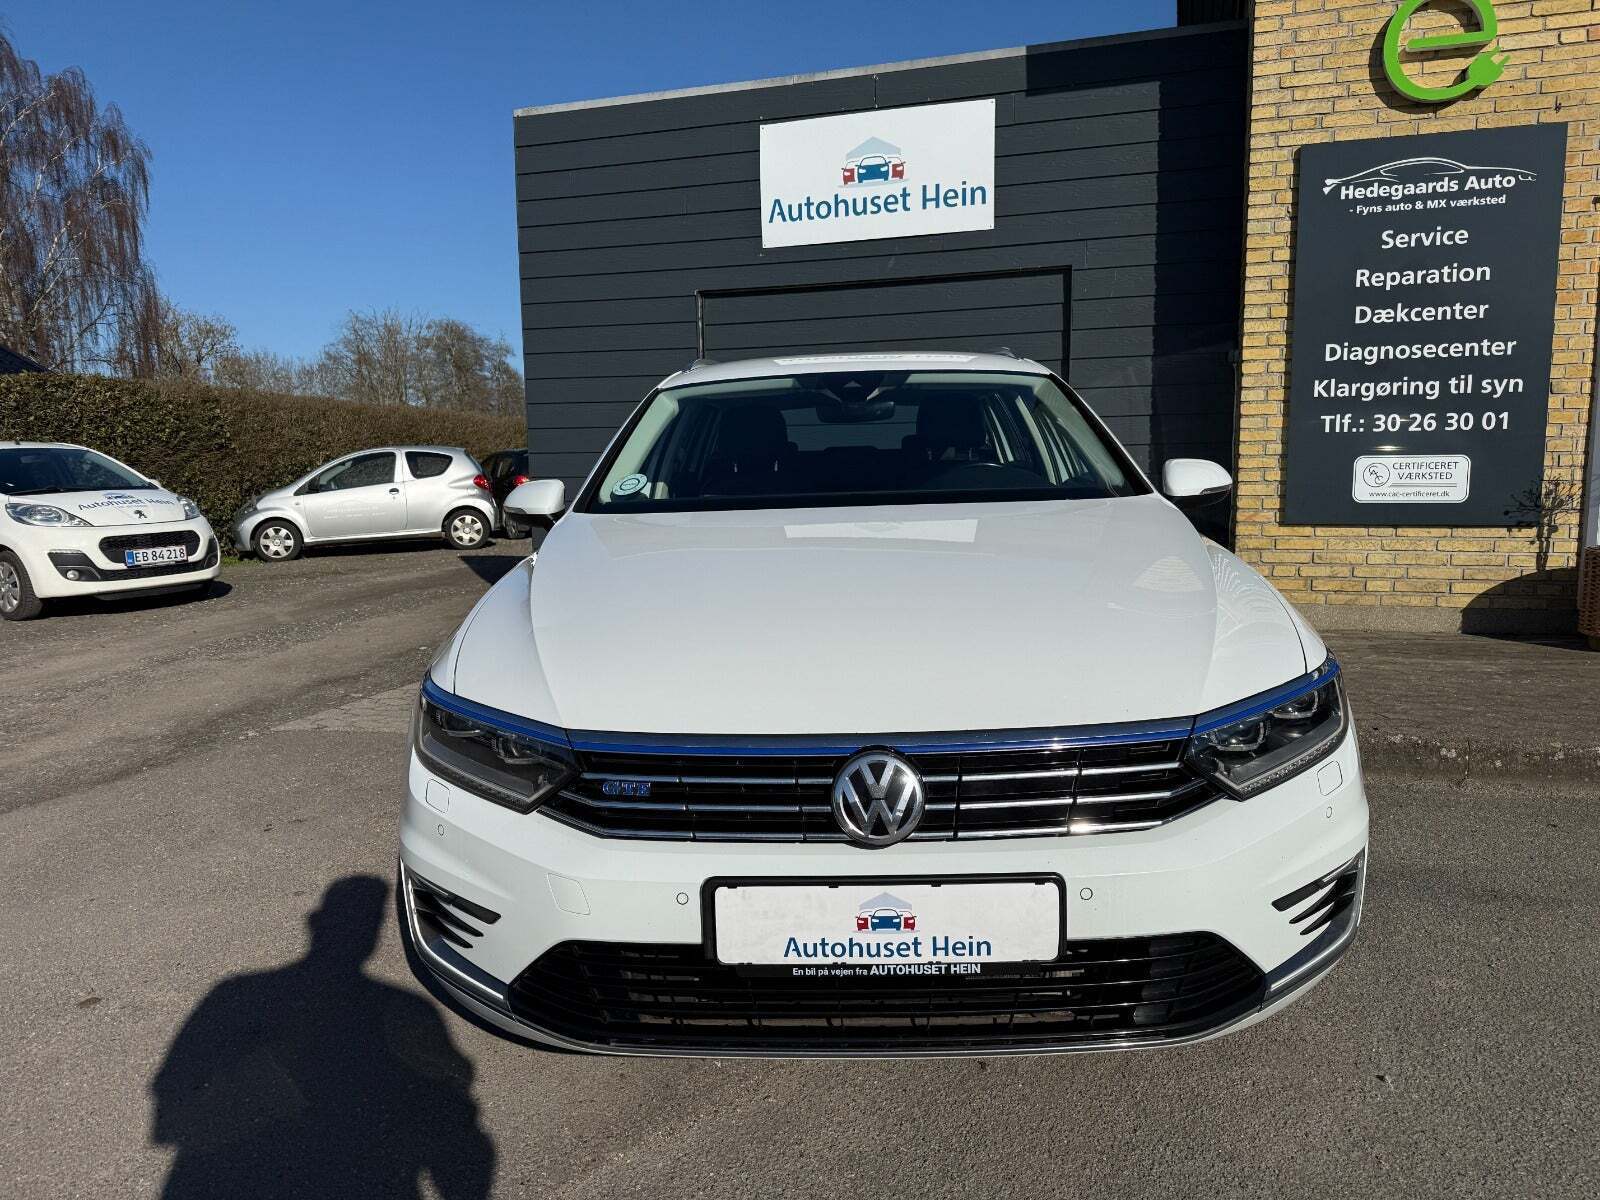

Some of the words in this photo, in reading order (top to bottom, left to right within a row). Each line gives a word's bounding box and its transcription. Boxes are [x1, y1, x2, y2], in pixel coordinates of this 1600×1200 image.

[1340, 177, 1459, 200] Hedegaards
[1464, 174, 1516, 191] Auto
[768, 187, 911, 223] Autohuset
[922, 181, 987, 210] Hein
[1356, 204, 1382, 215] Fyns
[1385, 202, 1412, 212] auto
[1415, 200, 1424, 209] &
[1427, 199, 1447, 209] MX
[1450, 194, 1507, 207] værksted
[1381, 226, 1469, 249] Service
[1355, 262, 1491, 290] Reparation
[1354, 303, 1489, 324] Dækcenter
[1324, 338, 1517, 365] Diagnosecenter
[1313, 376, 1440, 401] Klargøring
[1449, 375, 1472, 395] til
[1481, 377, 1523, 398] syn
[1321, 414, 1365, 433] Tlf.:
[1372, 414, 1400, 432] 30
[1408, 413, 1437, 432] 26
[1445, 412, 1474, 430] 30
[1482, 411, 1509, 430] 01
[1392, 461, 1460, 470] CERTIFICERET
[1397, 471, 1453, 480] VÆRKSTED
[135, 551, 149, 562] EB
[784, 937, 923, 958] Autohuset
[931, 935, 992, 957] Hein
[792, 967, 804, 976] En
[805, 966, 817, 976] bil
[818, 967, 829, 978] på
[831, 967, 854, 978] vejen
[855, 966, 868, 976] fra
[869, 964, 948, 976] AUTOHUSET
[950, 962, 981, 974] HEIN
